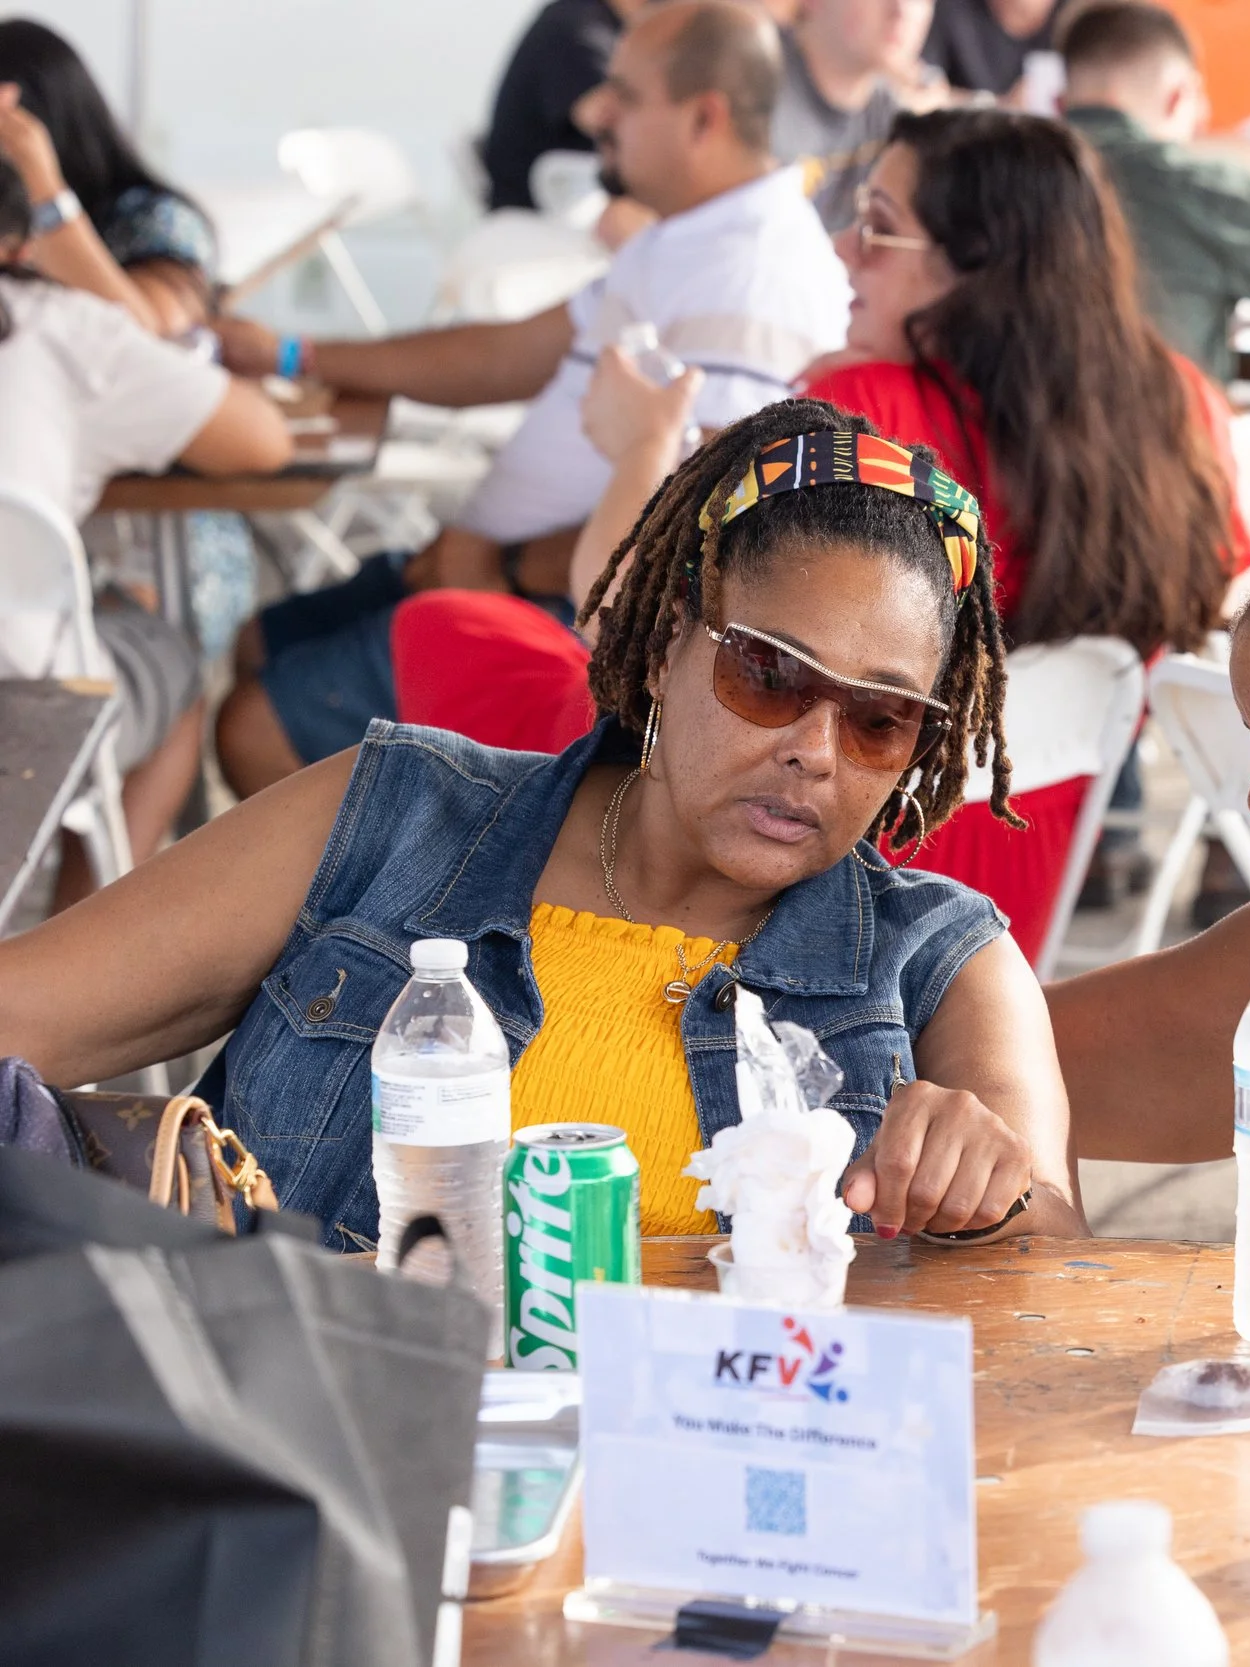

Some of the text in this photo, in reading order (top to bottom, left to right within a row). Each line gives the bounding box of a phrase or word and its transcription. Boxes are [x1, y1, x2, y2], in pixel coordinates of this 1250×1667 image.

[507, 1146, 577, 1370] Sprite
[715, 1349, 802, 1387] KFV
[672, 1414, 878, 1450] You Make The Difference
